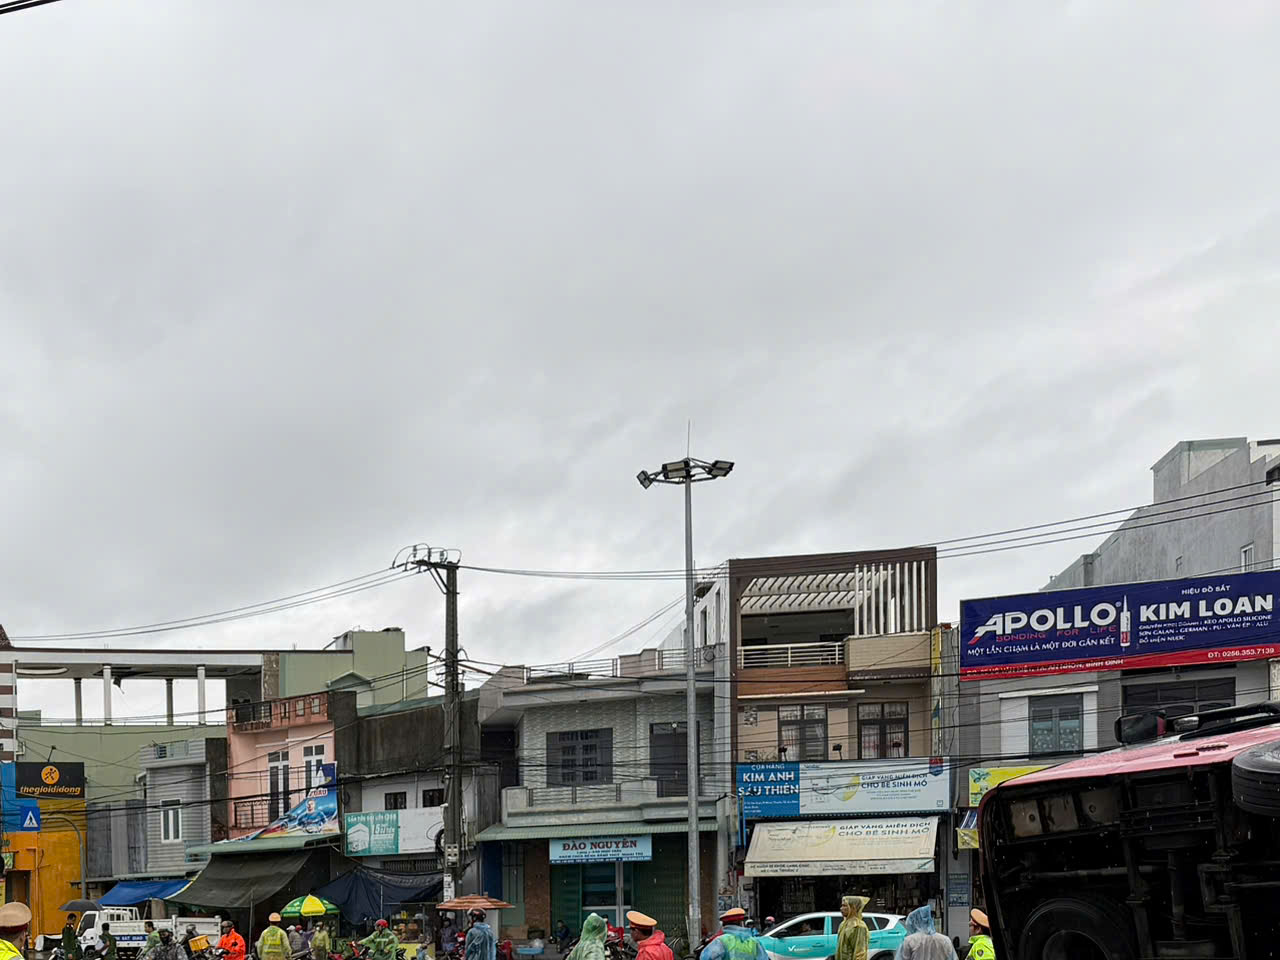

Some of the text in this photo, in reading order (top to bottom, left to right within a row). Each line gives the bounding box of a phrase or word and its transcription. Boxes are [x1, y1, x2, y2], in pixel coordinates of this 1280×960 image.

[1140, 594, 1274, 622] KIM LOAN
[968, 602, 1117, 645] APOLLO
[1218, 616, 1242, 624] APOLLO
[995, 625, 1118, 642] BONDING FOR LIFE
[967, 647, 984, 656] MỘT
[1030, 642, 1041, 650] LÀ
[1042, 641, 1060, 651] MỘT
[743, 771, 795, 782] KIM ANH
[861, 781, 879, 789] CHO
[892, 780, 912, 788] SINH
[881, 828, 909, 836] SINH
[562, 840, 586, 851] ĐÀO
